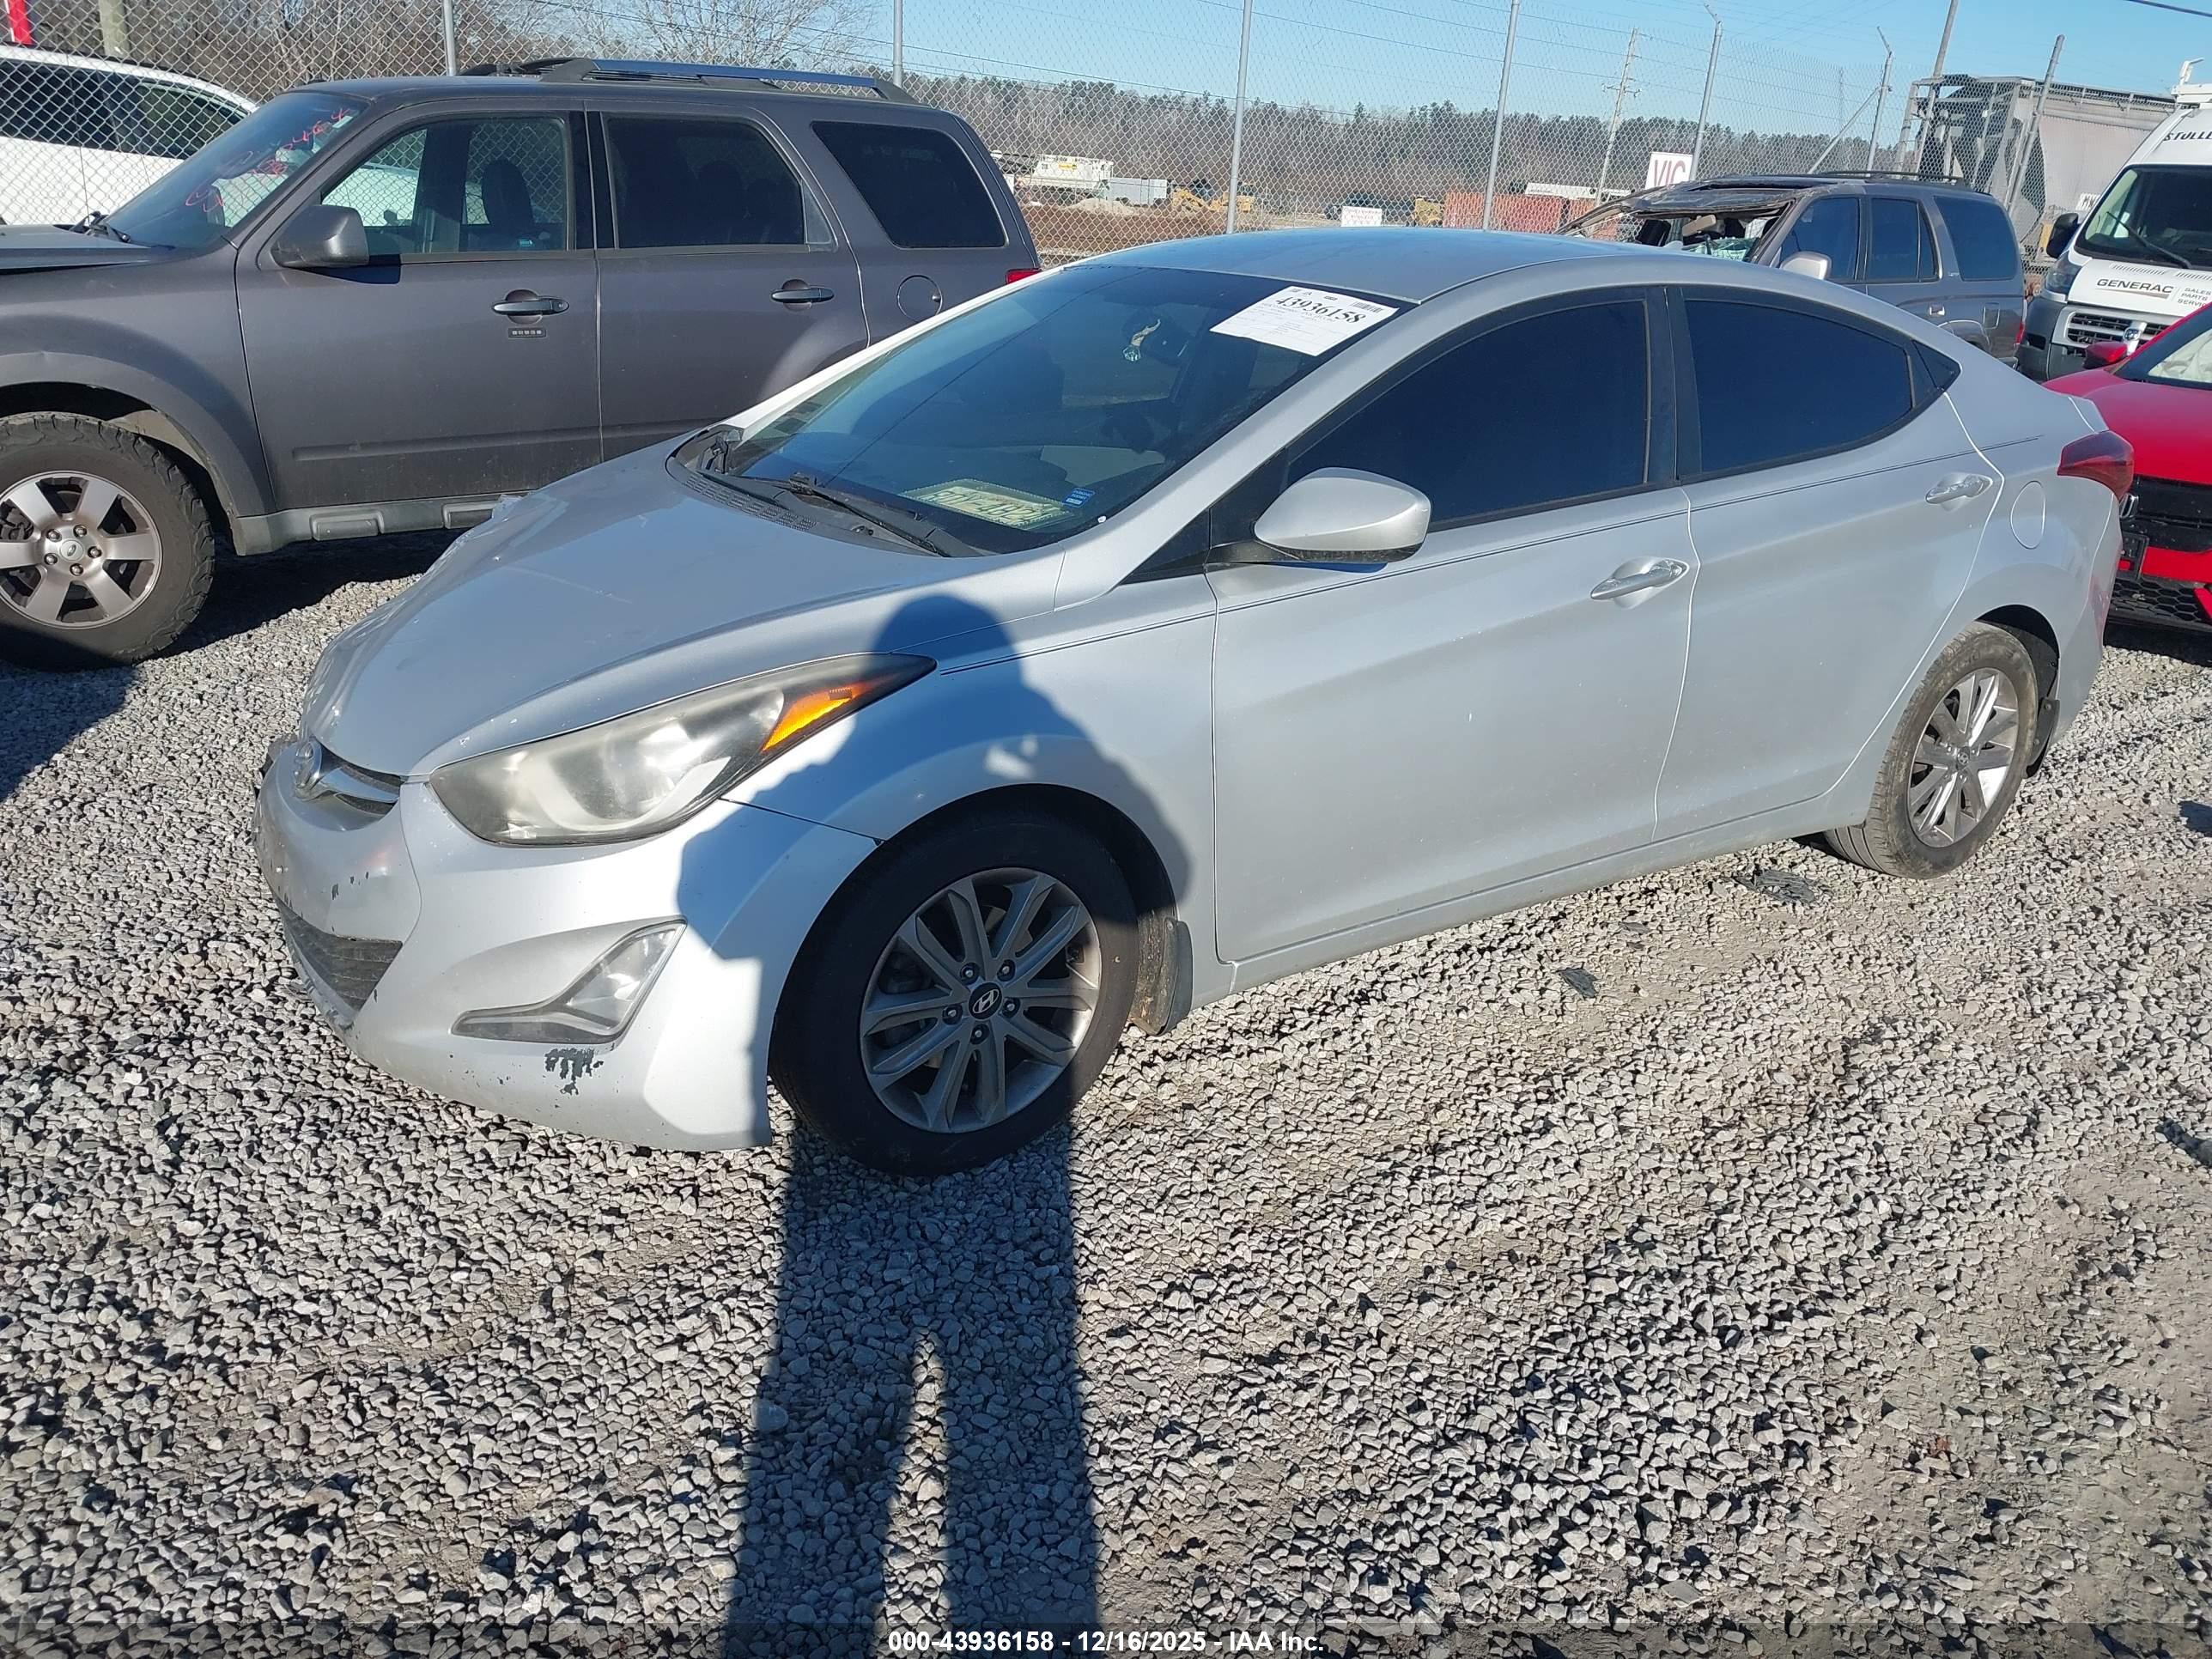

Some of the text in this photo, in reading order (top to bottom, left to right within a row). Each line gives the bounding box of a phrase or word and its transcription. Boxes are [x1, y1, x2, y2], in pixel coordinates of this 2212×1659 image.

[2096, 278, 2174, 294] GENERAC
[2185, 287, 2212, 295] SALES
[2181, 293, 2209, 301] PARTS
[1274, 296, 1367, 324] 43936158
